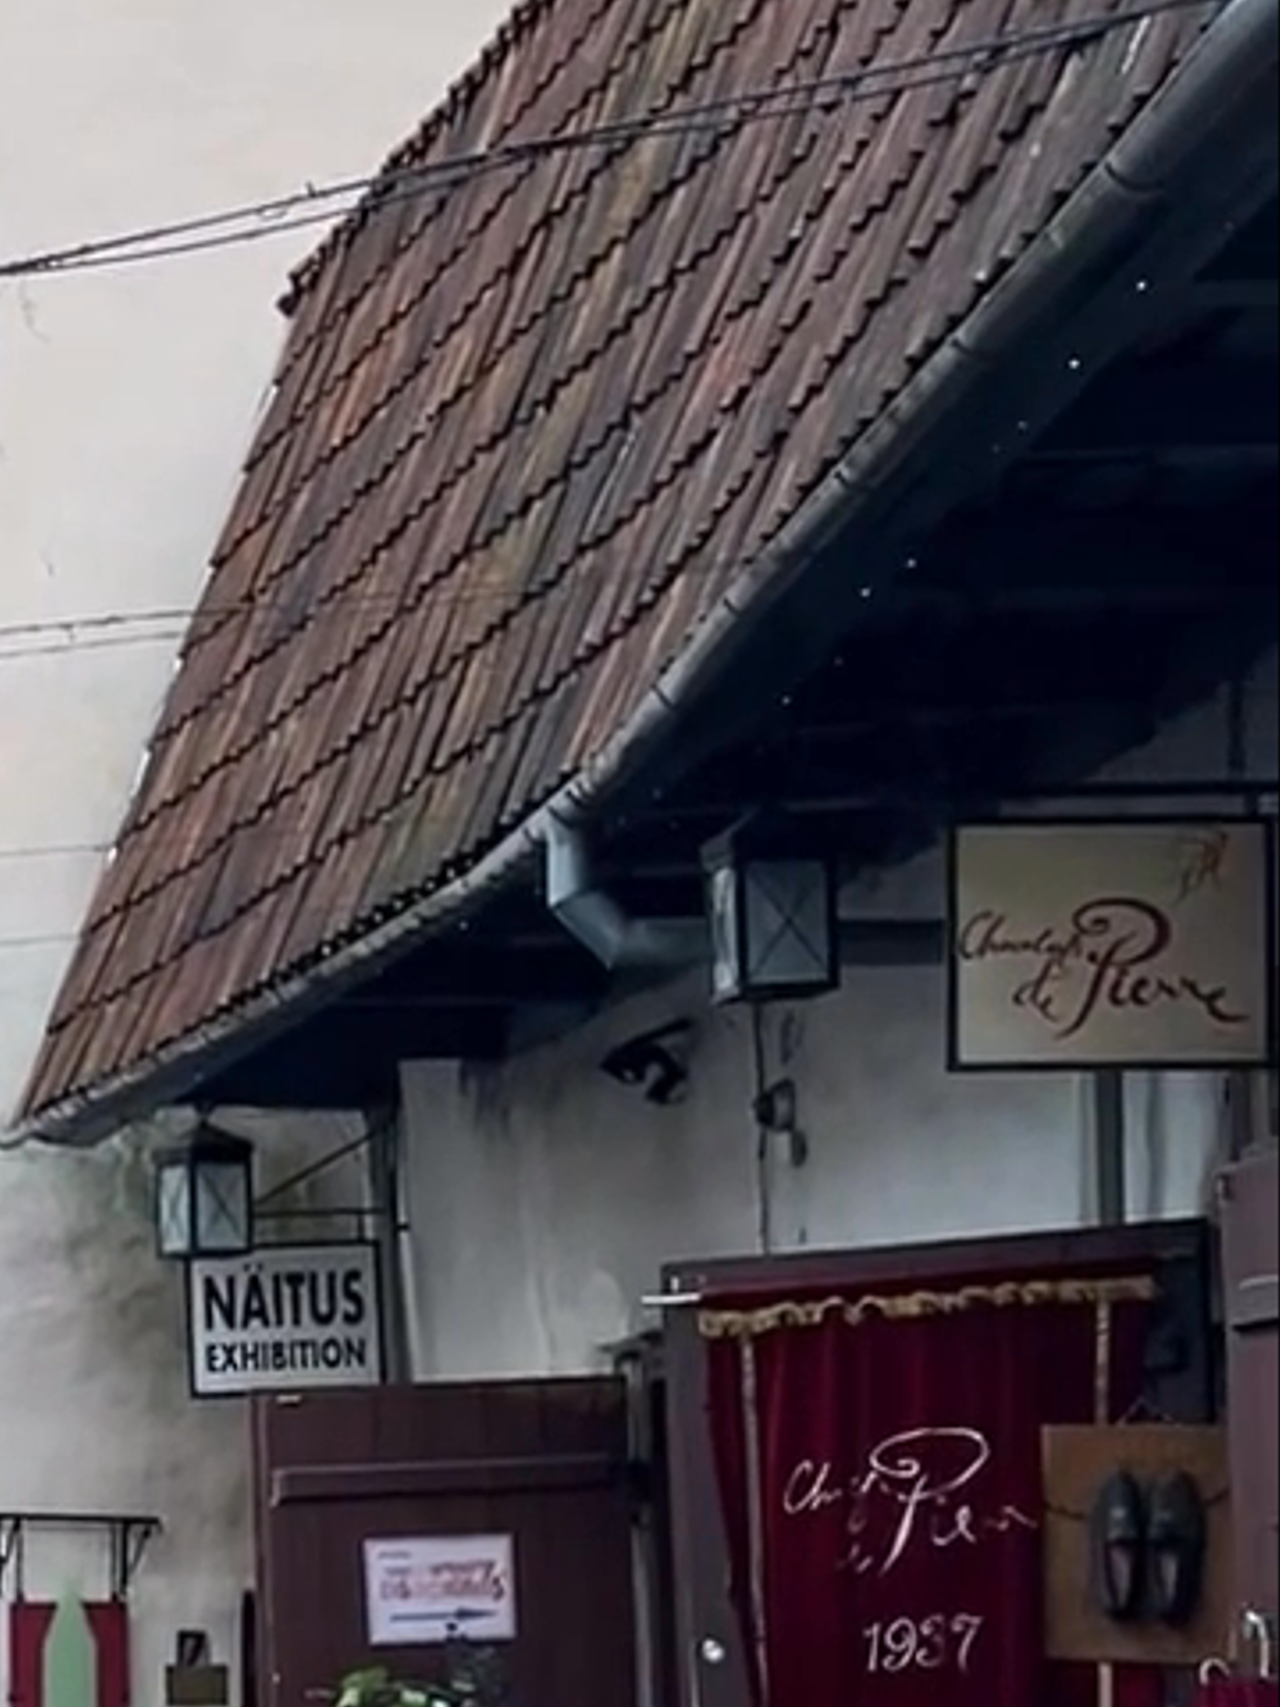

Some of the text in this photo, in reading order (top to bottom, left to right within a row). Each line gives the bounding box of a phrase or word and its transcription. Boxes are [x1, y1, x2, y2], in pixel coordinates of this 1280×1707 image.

[1053, 897, 1250, 1041] Pierre
[204, 1263, 366, 1332] NÄITUS
[206, 1338, 367, 1372] EXHIBITION
[863, 1614, 984, 1673] 1937
